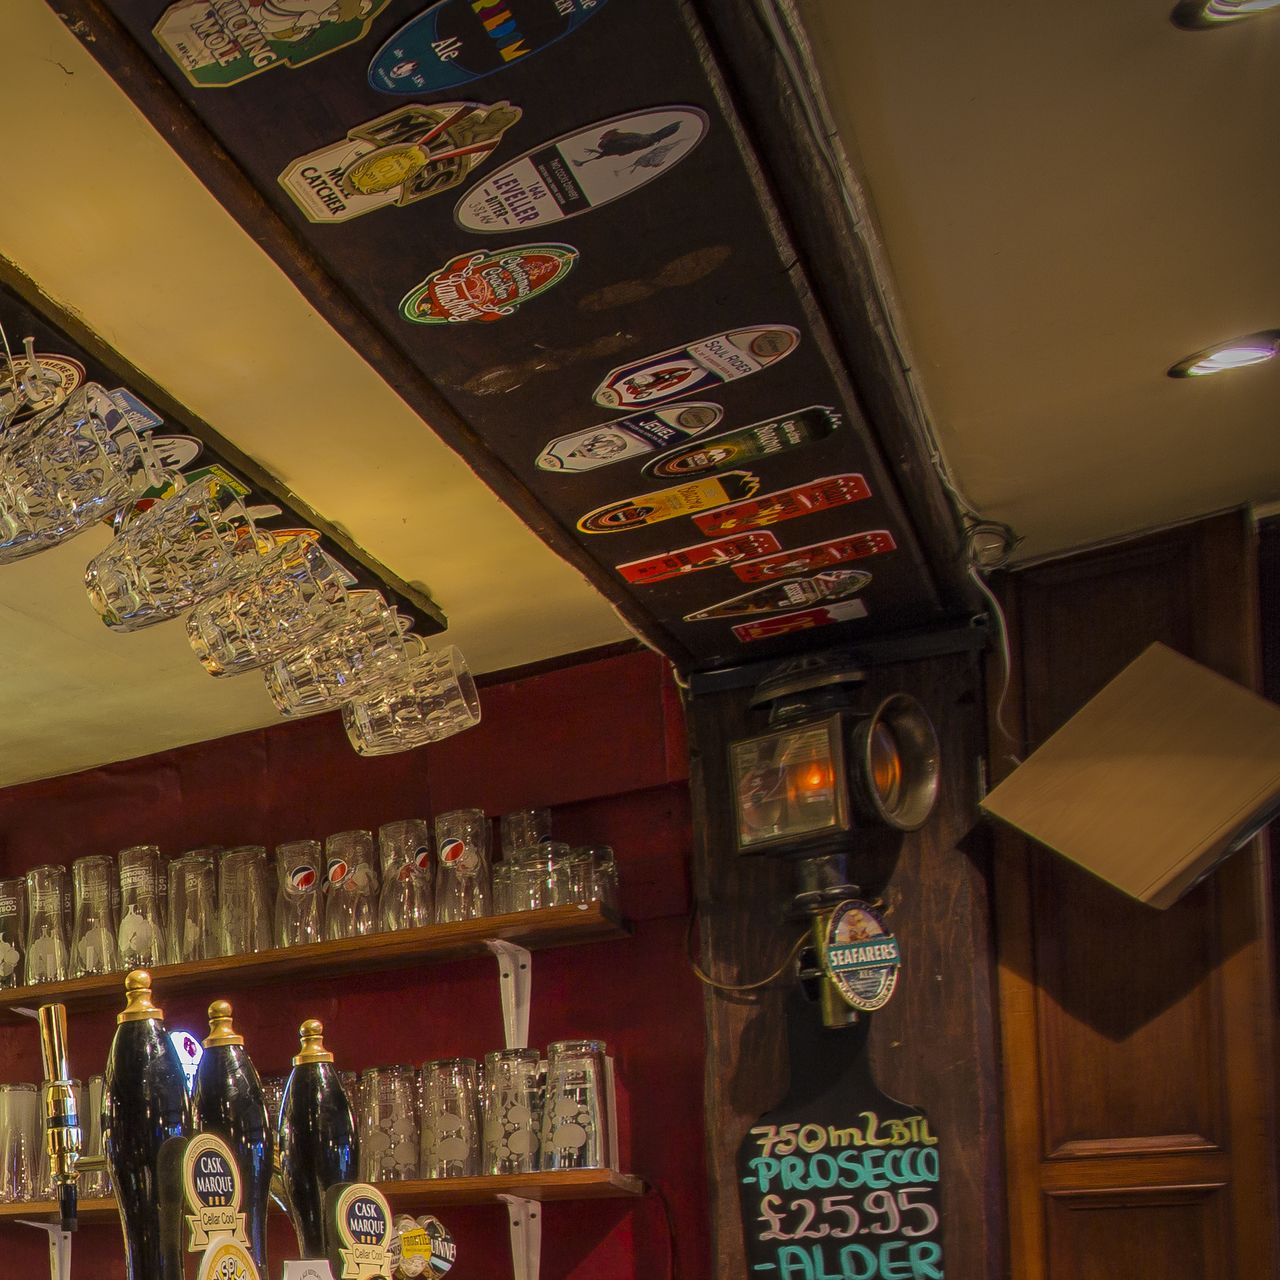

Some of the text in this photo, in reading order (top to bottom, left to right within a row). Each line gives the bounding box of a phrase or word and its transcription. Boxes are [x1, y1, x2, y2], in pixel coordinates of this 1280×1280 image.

[191, 20, 242, 67] MOLE
[431, 36, 463, 62] Ale
[300, 166, 348, 215] CATCHER
[492, 172, 541, 224] LEVELLER
[487, 195, 507, 220] BITTER
[499, 256, 533, 298] Christmas
[705, 340, 753, 375] SOUL RIDER
[639, 419, 676, 440] JEWEL
[830, 943, 898, 966] SEAFARERS
[200, 1156, 223, 1174] CASK
[196, 1176, 234, 1194] MARQUE
[202, 1211, 235, 1227] Cellar Cool
[355, 1202, 378, 1218] CASK
[758, 1187, 940, 1242] £25.95
[350, 1218, 385, 1234] MARQUE
[354, 1248, 384, 1261] Cellar Cool
